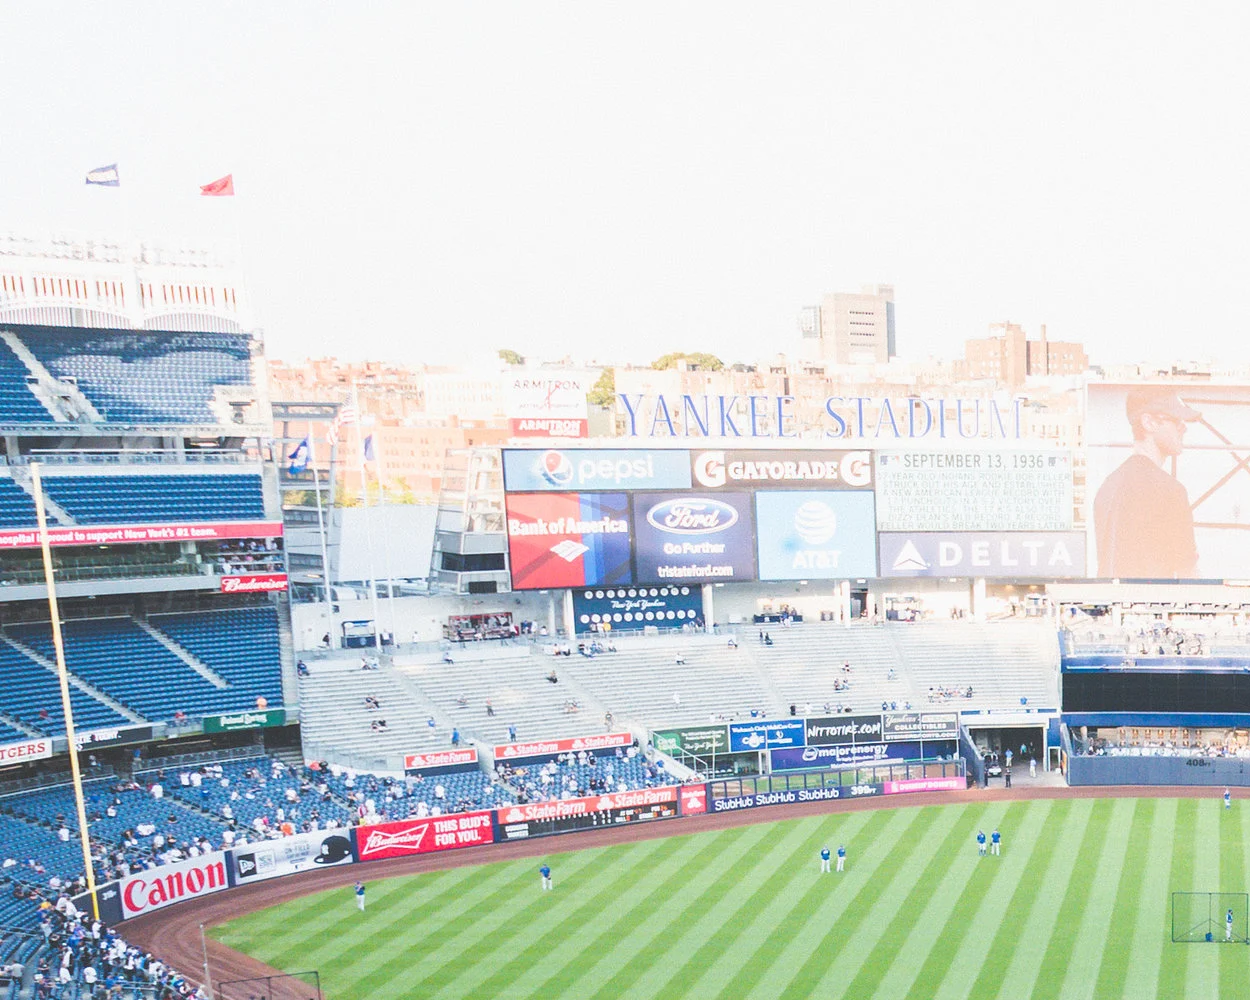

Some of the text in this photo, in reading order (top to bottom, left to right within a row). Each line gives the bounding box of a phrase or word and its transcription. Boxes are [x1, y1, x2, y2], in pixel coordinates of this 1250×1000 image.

[619, 393, 1023, 438] YANKEE STADIUM
[519, 420, 580, 431] ARMITRON
[578, 454, 653, 484] pepsi
[728, 461, 838, 480] GATORADE
[904, 454, 1044, 470] SEPTEMBER 13, 1936
[665, 503, 720, 528] Ford
[508, 516, 628, 536] Bank of America
[86, 530, 123, 543] support
[124, 529, 147, 540] New
[663, 542, 726, 555] Go Further
[939, 541, 1073, 567] DELTA
[791, 551, 841, 570] AT&T
[222, 578, 287, 592] Budweiser
[807, 722, 881, 738] NITTOTIRE.COM
[714, 788, 839, 811] StubHub StubHub StubHub
[434, 814, 490, 833] THIS BUD'S
[370, 829, 423, 850] Budweiser
[435, 828, 482, 847] FOR YOU.
[124, 861, 226, 913] Canon
